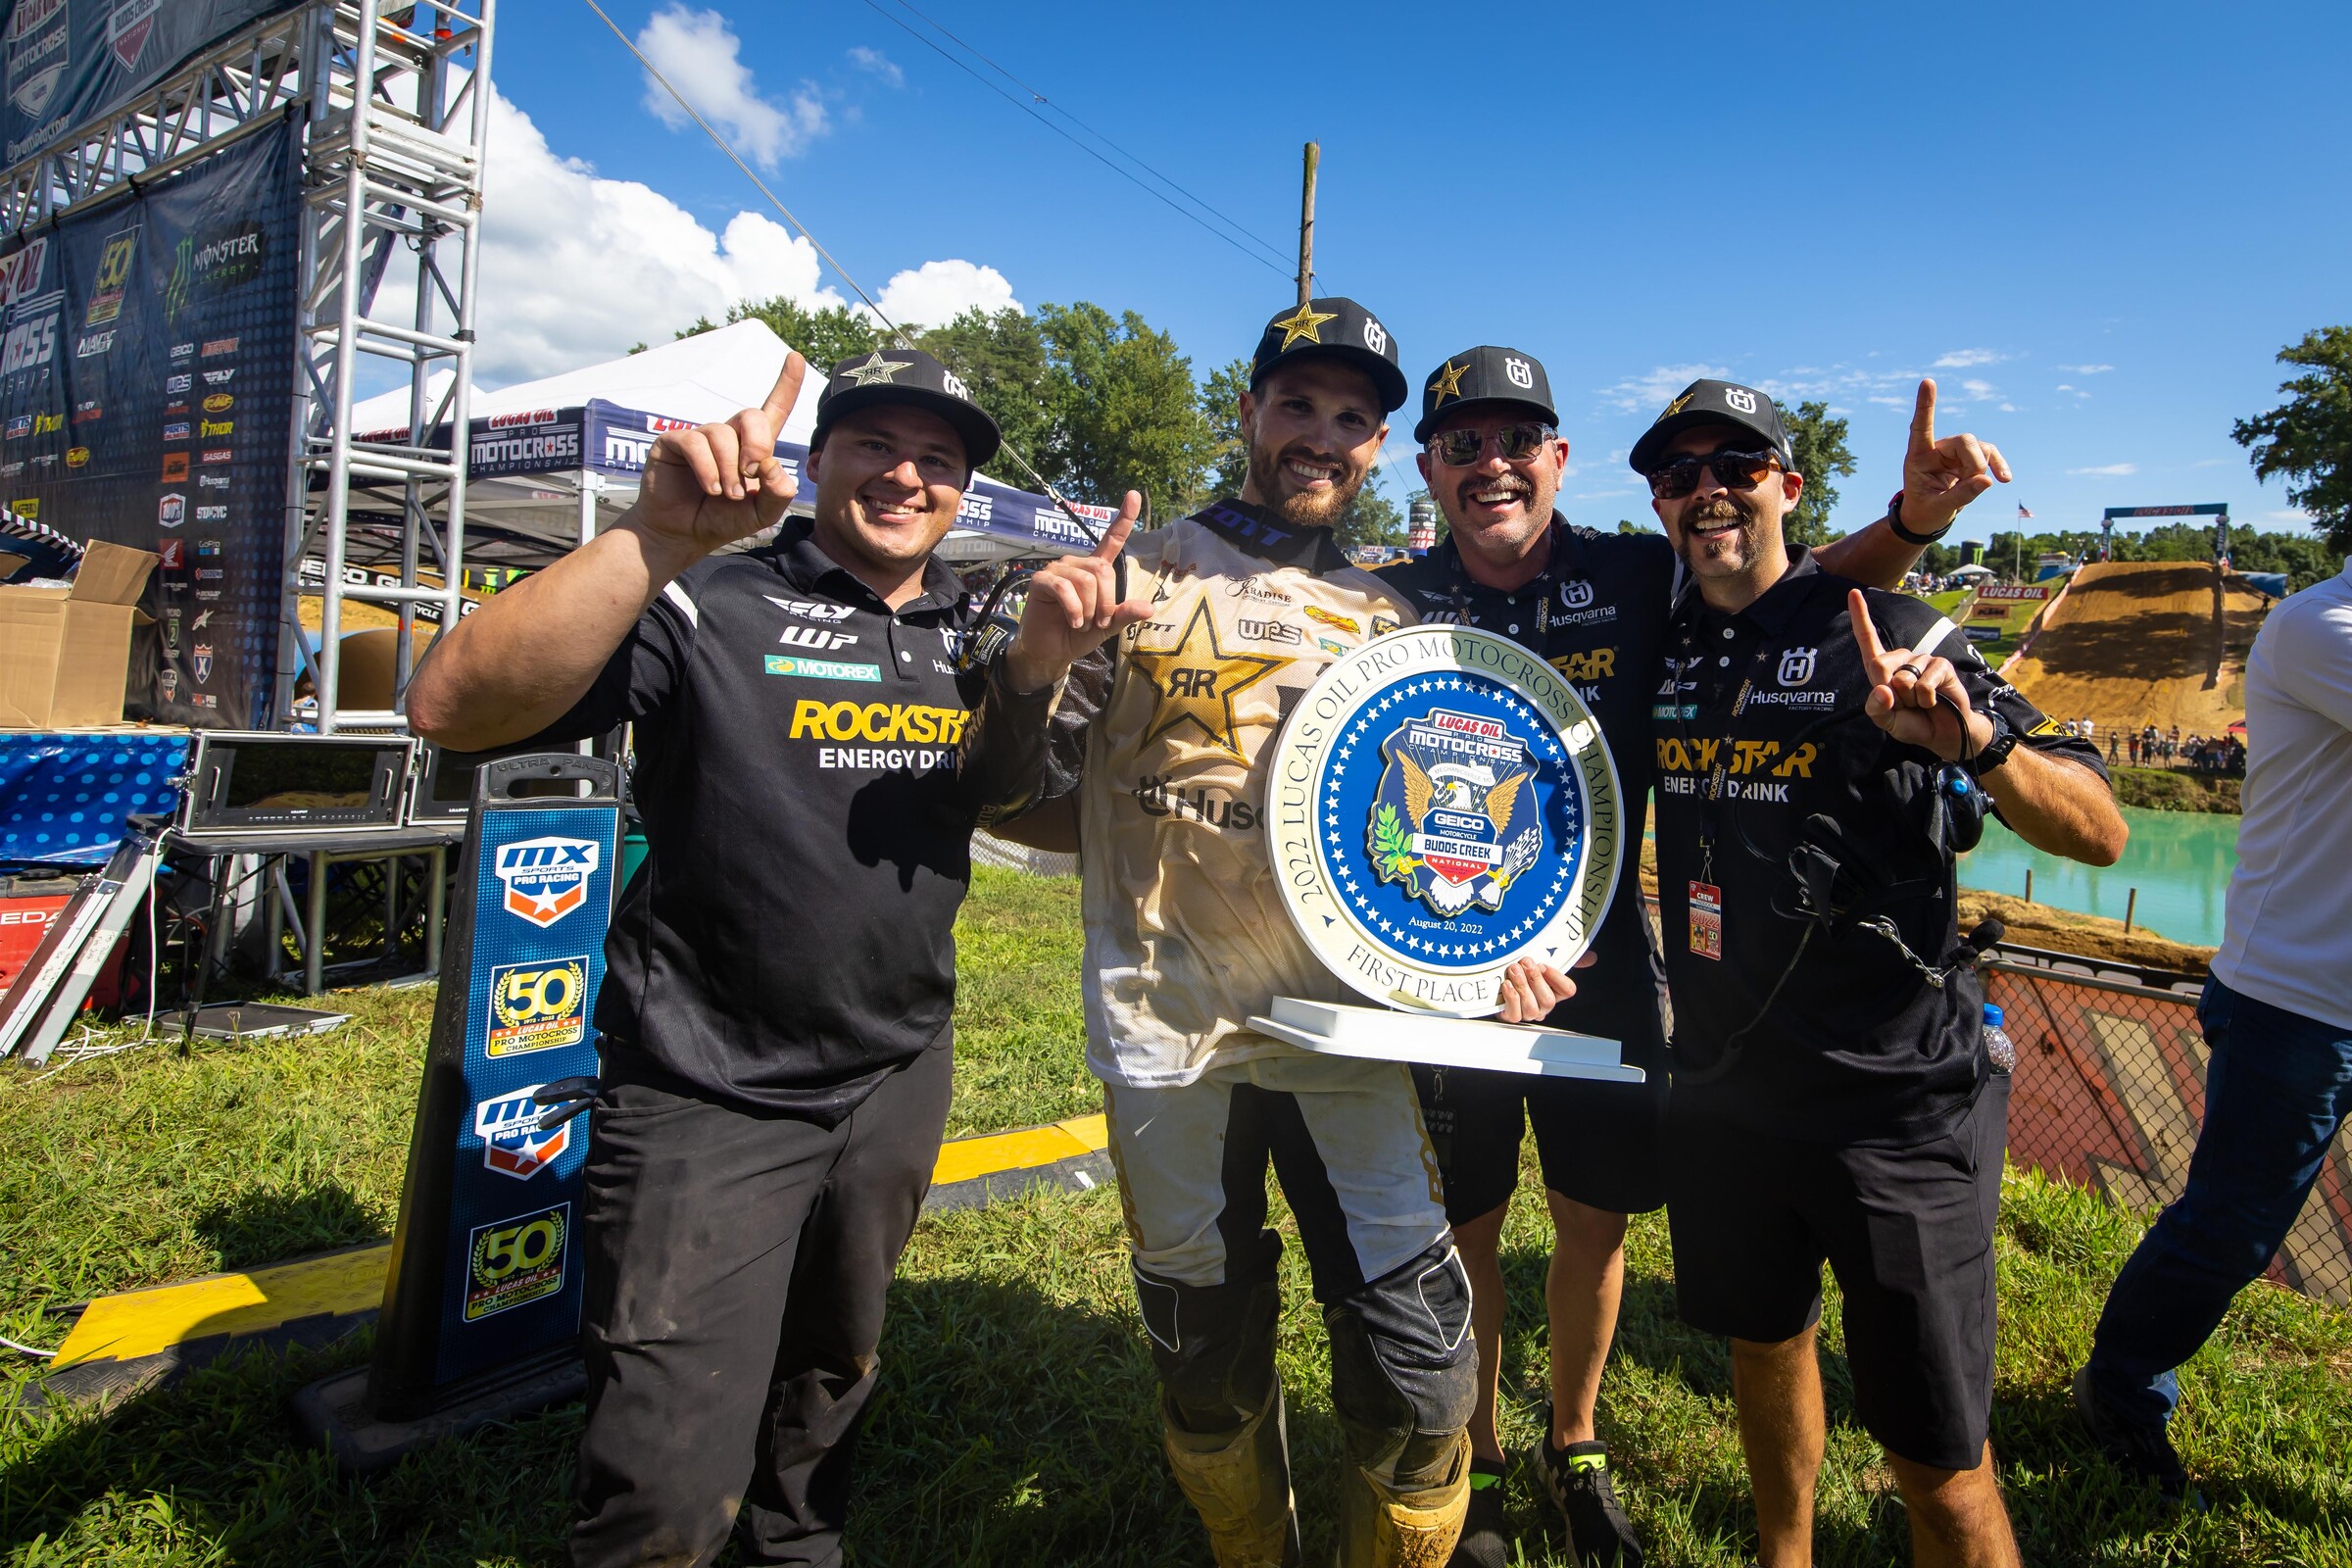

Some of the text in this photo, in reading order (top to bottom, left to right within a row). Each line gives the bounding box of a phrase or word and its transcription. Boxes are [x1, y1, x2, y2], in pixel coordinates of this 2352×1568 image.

[194, 232, 260, 271] MONSTER
[492, 410, 530, 427] LUCAS
[508, 427, 538, 437] PRO
[471, 434, 579, 465] MOTOCROSS
[1981, 586, 2043, 599] LUCAS OIL
[779, 625, 858, 650] WP
[1238, 619, 1302, 646] WPS
[798, 660, 876, 679] MOTOREX
[1750, 690, 1835, 706] Husqvarna
[1438, 714, 1500, 737] LUCAS OIL
[1408, 731, 1523, 763] MOTOCROSS
[1408, 743, 1523, 767] CHAMPIONSHIP
[497, 758, 611, 773] ULTRA PANEL
[819, 748, 914, 768] ENERGY
[1283, 635, 1614, 943] 2022 LUCAS OIL PRO MOTOCROSS CHAMPIONSHIP
[1434, 813, 1485, 830] GEICO
[1439, 829, 1478, 840] MOTORCYCLE
[502, 845, 595, 868] MX
[1424, 838, 1491, 859] BUDDS CREEK
[1431, 857, 1482, 869] NATIONAL
[514, 873, 579, 885] PRO RACING
[1696, 892, 1714, 902] CREW
[1408, 915, 1483, 935] August 20, 2022
[1690, 909, 1719, 929] 2022
[1347, 943, 1404, 994] FIRST
[1415, 977, 1488, 1003] PLACE
[504, 968, 576, 1021] 50
[494, 1027, 578, 1048] PRO MOTOCROSS
[516, 1021, 560, 1035] LUCAS OIL
[506, 1037, 567, 1053] CHAMPIONSHIP
[495, 1130, 518, 1142] PRO
[481, 1219, 559, 1279] 50
[470, 1277, 559, 1310] PRO MOTOCROSS
[495, 1274, 539, 1295] LUCAS OIL
[483, 1288, 546, 1312] CHAMPIONSHIP
